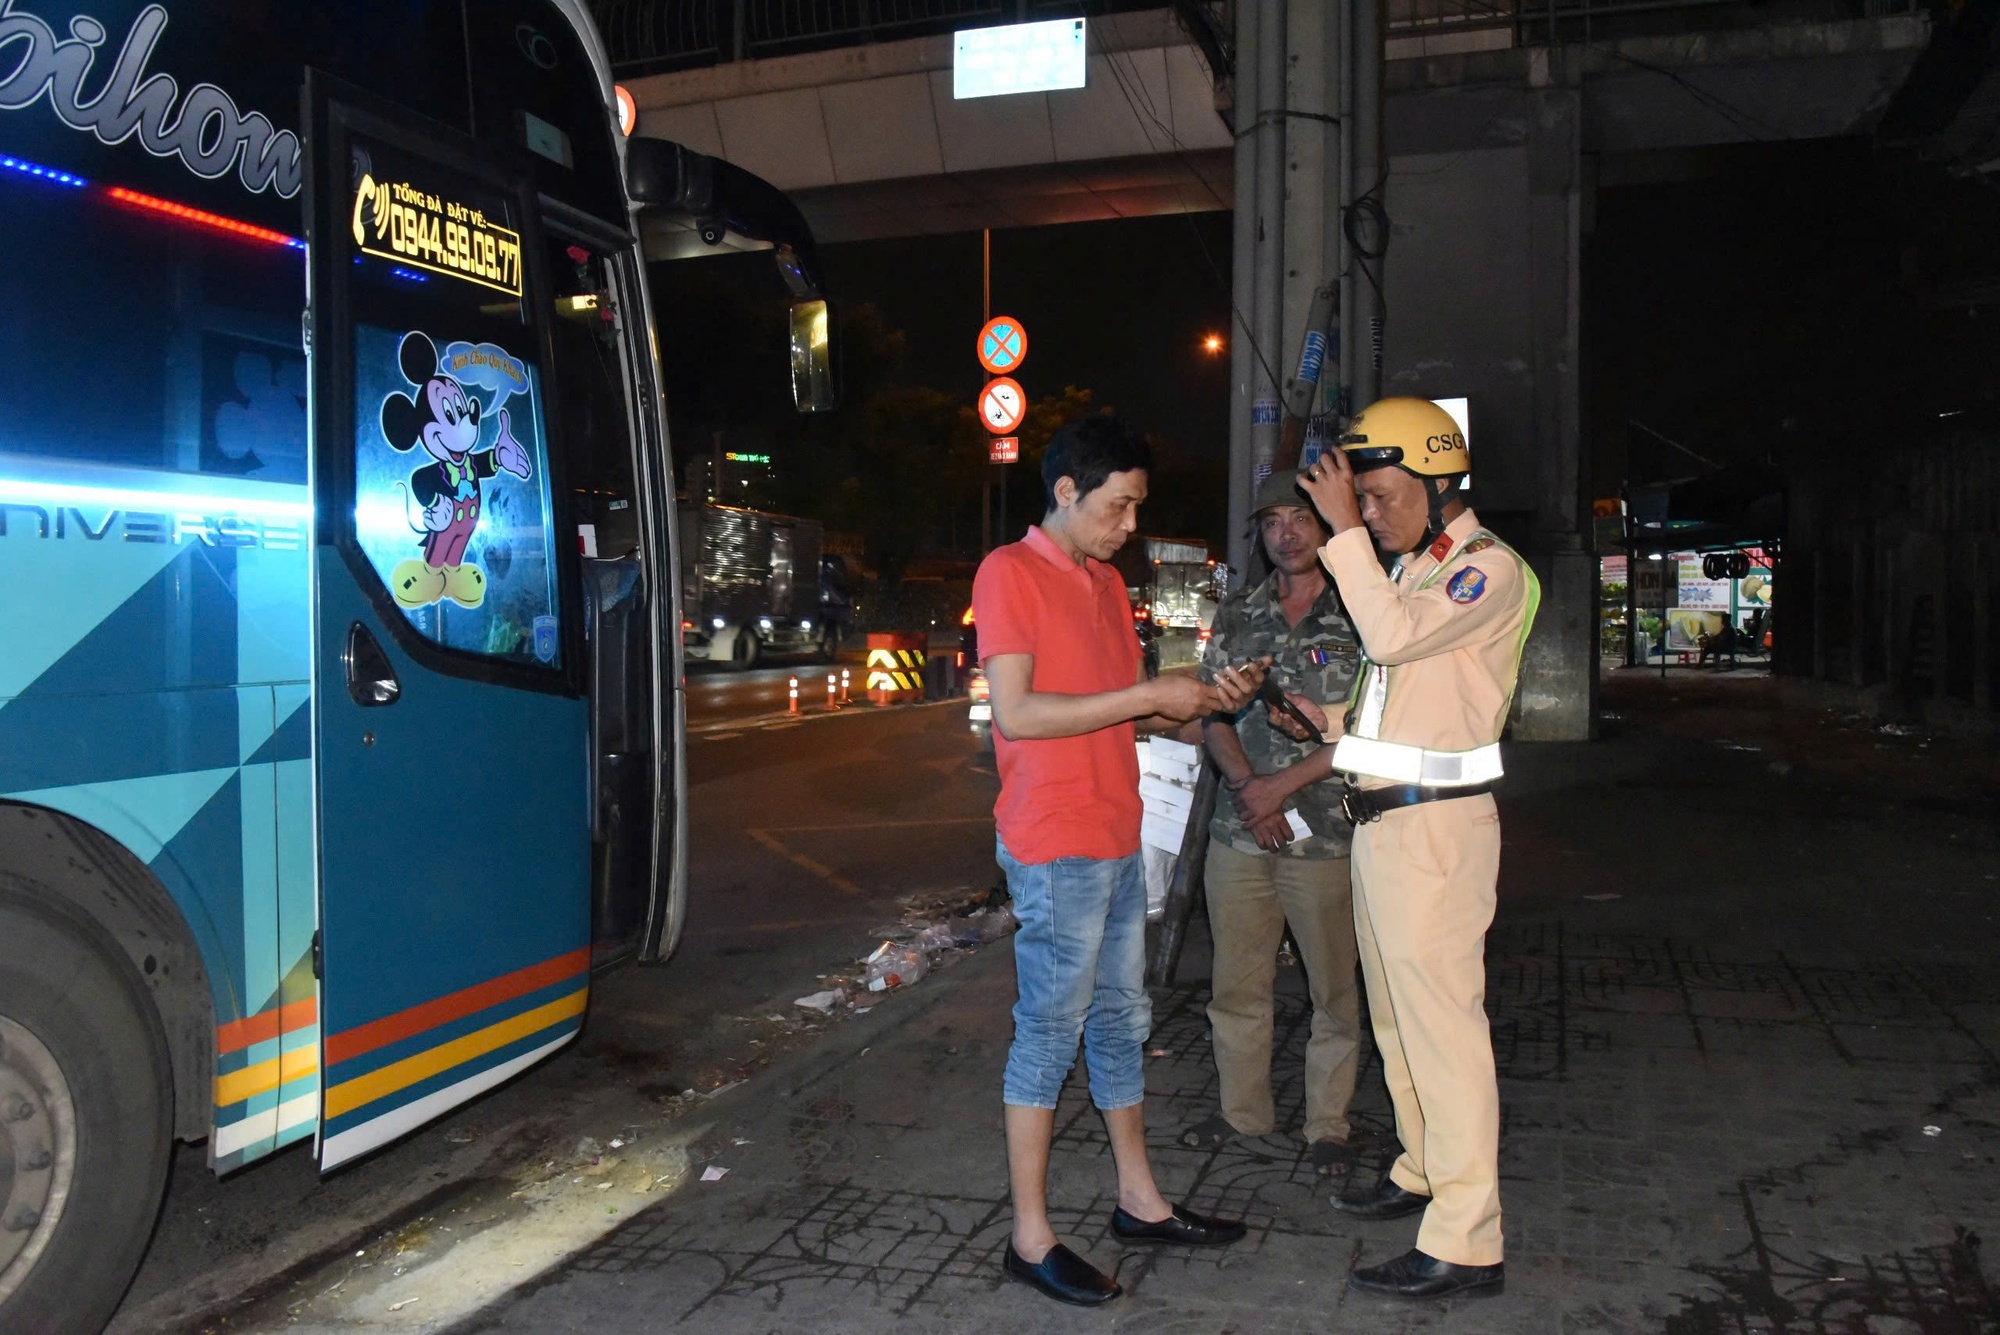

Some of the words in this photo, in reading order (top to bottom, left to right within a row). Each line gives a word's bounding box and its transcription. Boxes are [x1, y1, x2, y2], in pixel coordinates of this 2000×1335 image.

[392, 182, 425, 208] TỔNG
[426, 195, 443, 214] ĐÀ
[447, 202, 469, 223] ĐẶT
[390, 203, 518, 287] 0944.99.09.77
[1426, 432, 1465, 453] CSG
